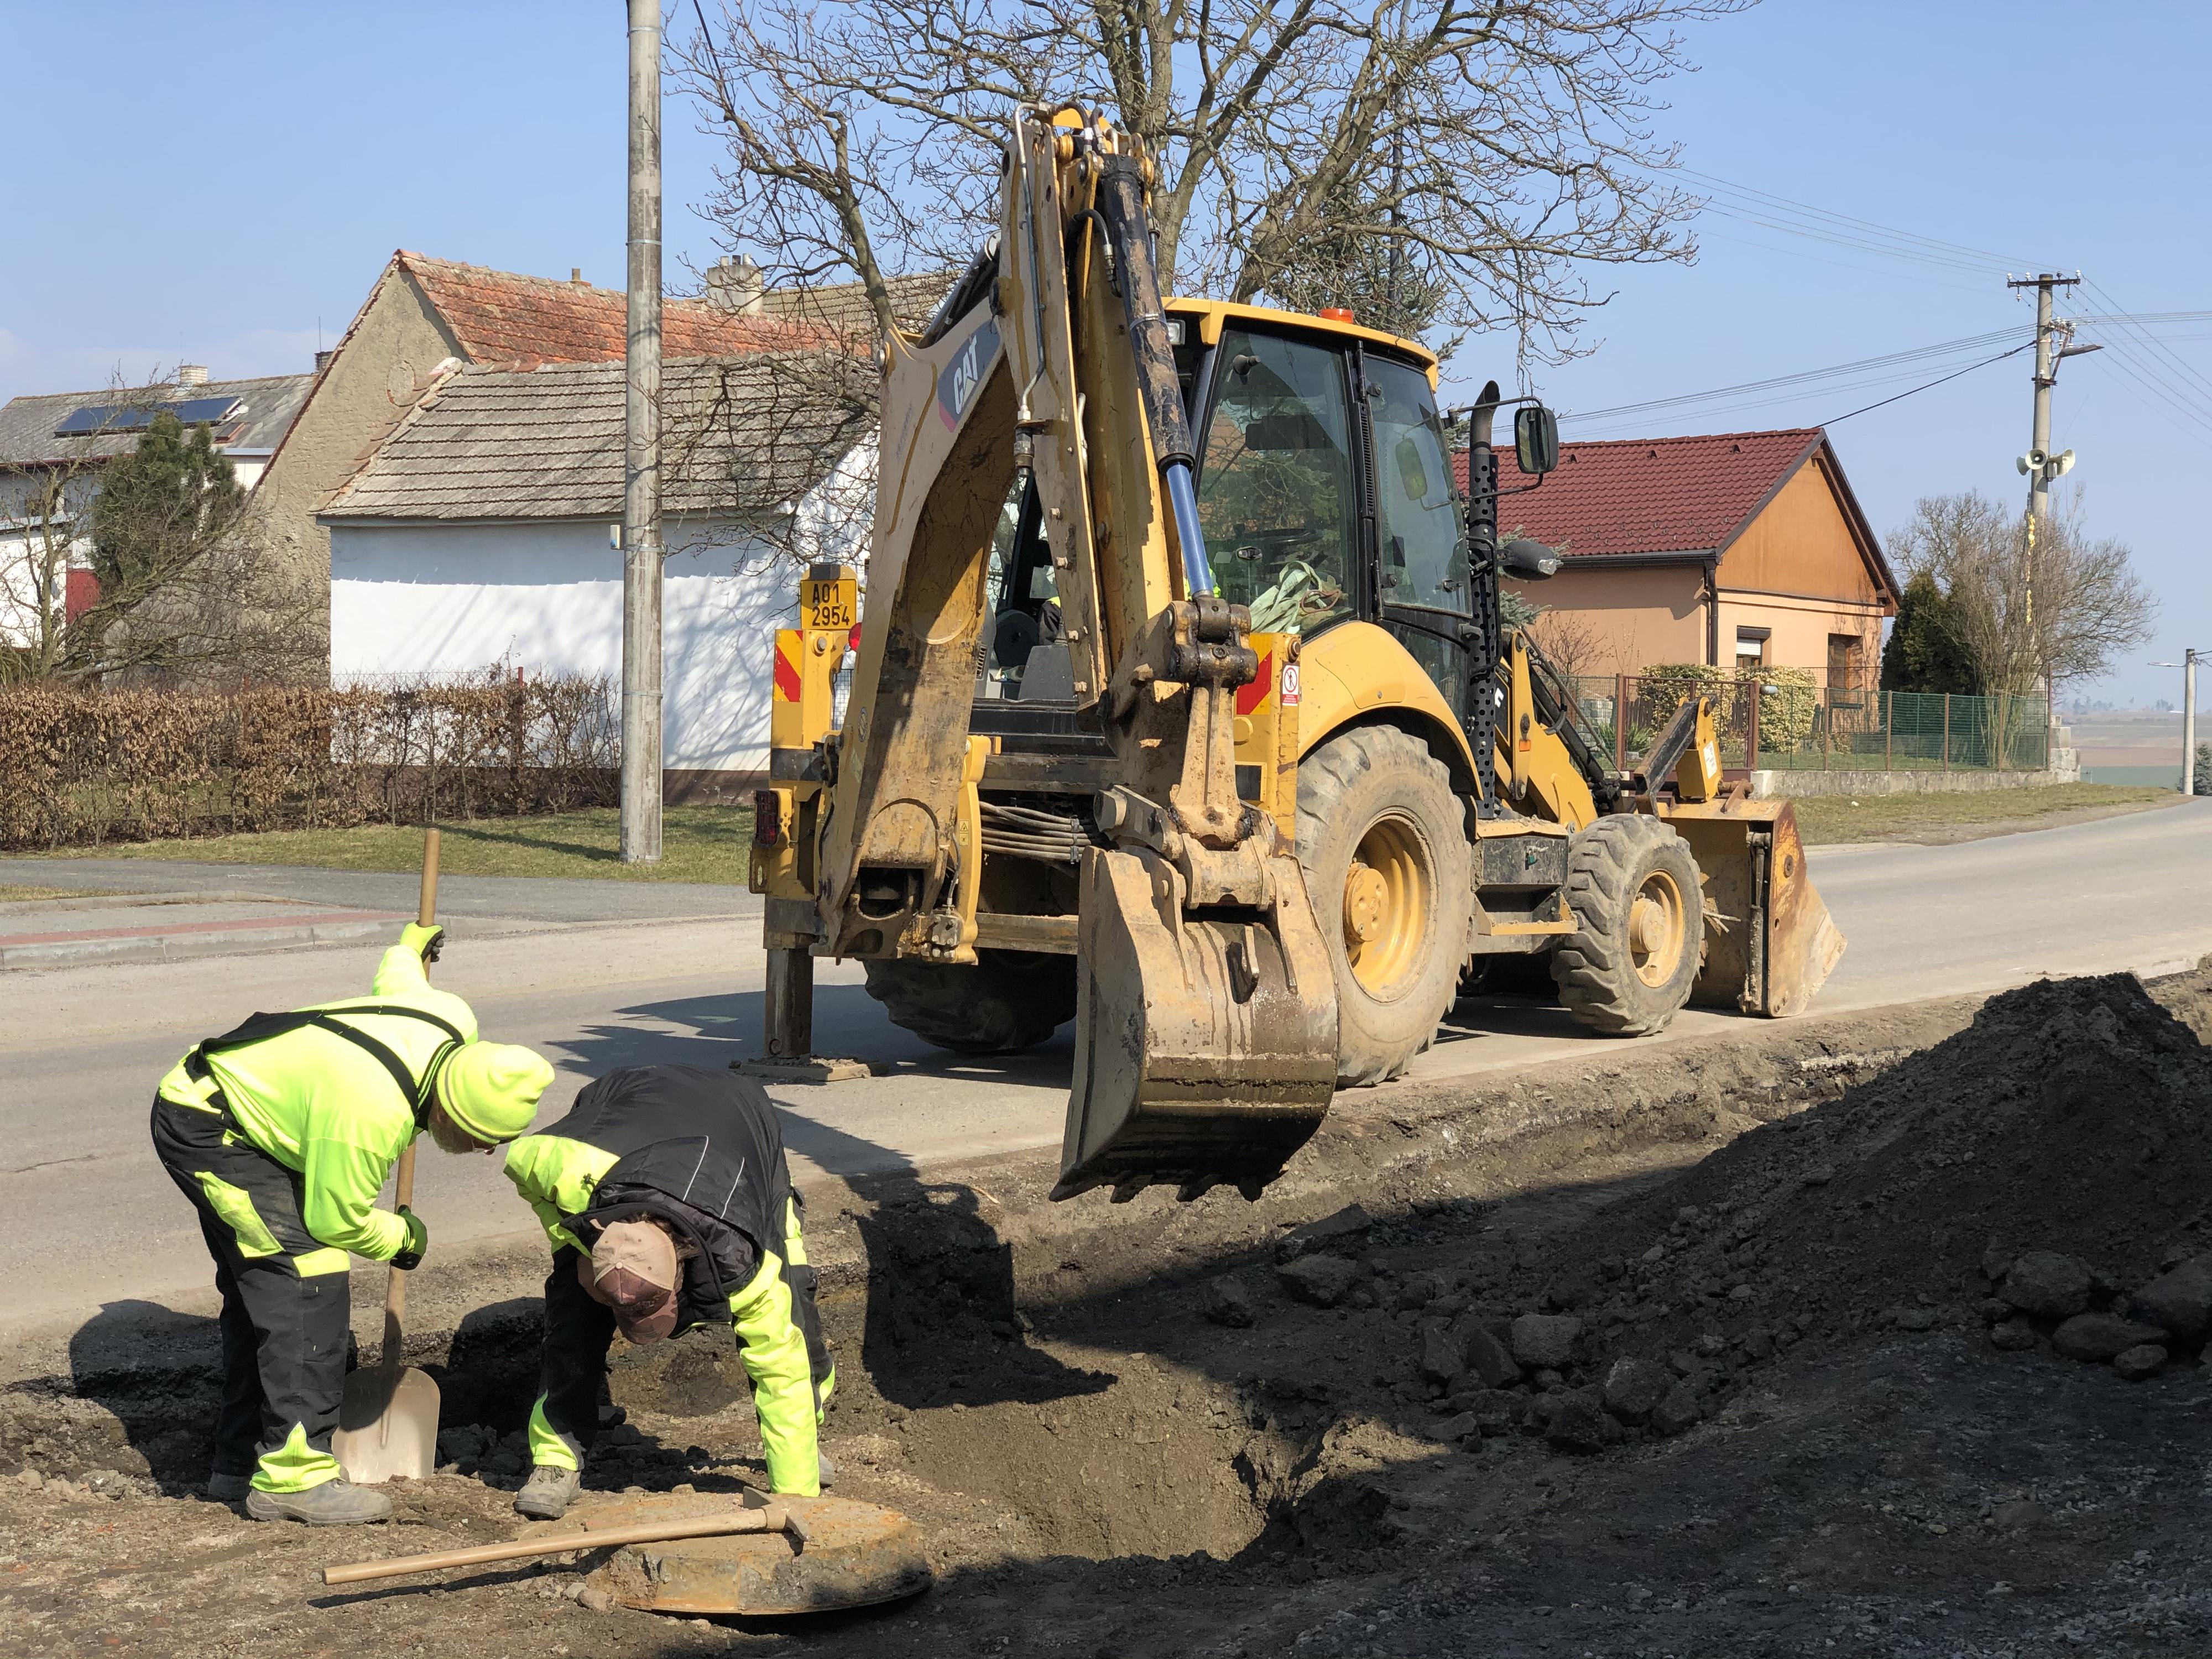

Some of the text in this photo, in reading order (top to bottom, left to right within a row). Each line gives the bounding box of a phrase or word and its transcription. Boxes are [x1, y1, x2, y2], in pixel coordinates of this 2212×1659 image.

[954, 335, 978, 414] CAT
[812, 583, 839, 603] A01
[812, 606, 850, 626] 2954
